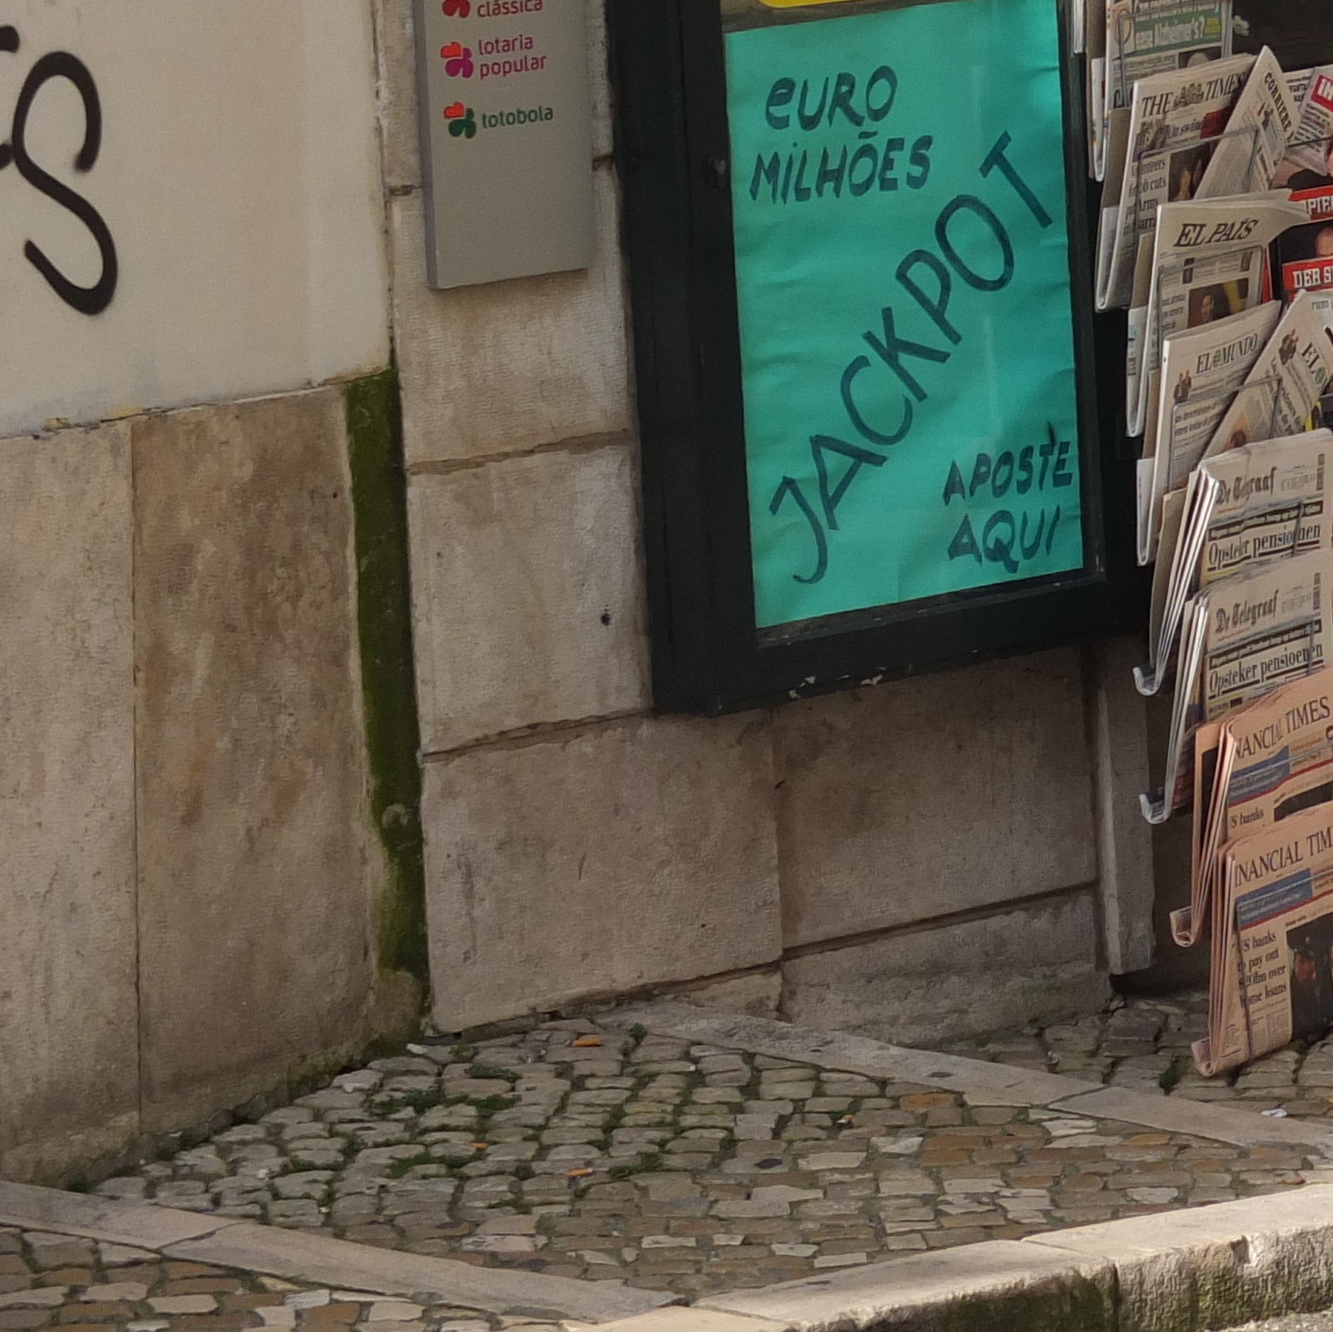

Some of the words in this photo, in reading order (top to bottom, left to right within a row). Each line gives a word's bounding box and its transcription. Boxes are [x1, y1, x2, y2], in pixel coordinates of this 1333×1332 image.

[478, 34, 533, 55] lotaria
[479, 54, 546, 80] popular
[1142, 94, 1172, 118] THE
[1206, 72, 1247, 100] TIMES
[481, 104, 553, 129] totobola
[1173, 223, 1207, 248] EL
[1208, 218, 1259, 243] PAÍS
[1293, 270, 1319, 287] DER
[768, 129, 1053, 586] JACKPOT
[942, 440, 1073, 506] APOSTE
[947, 506, 1061, 574] AQUI
[1285, 696, 1331, 734] TIMES
